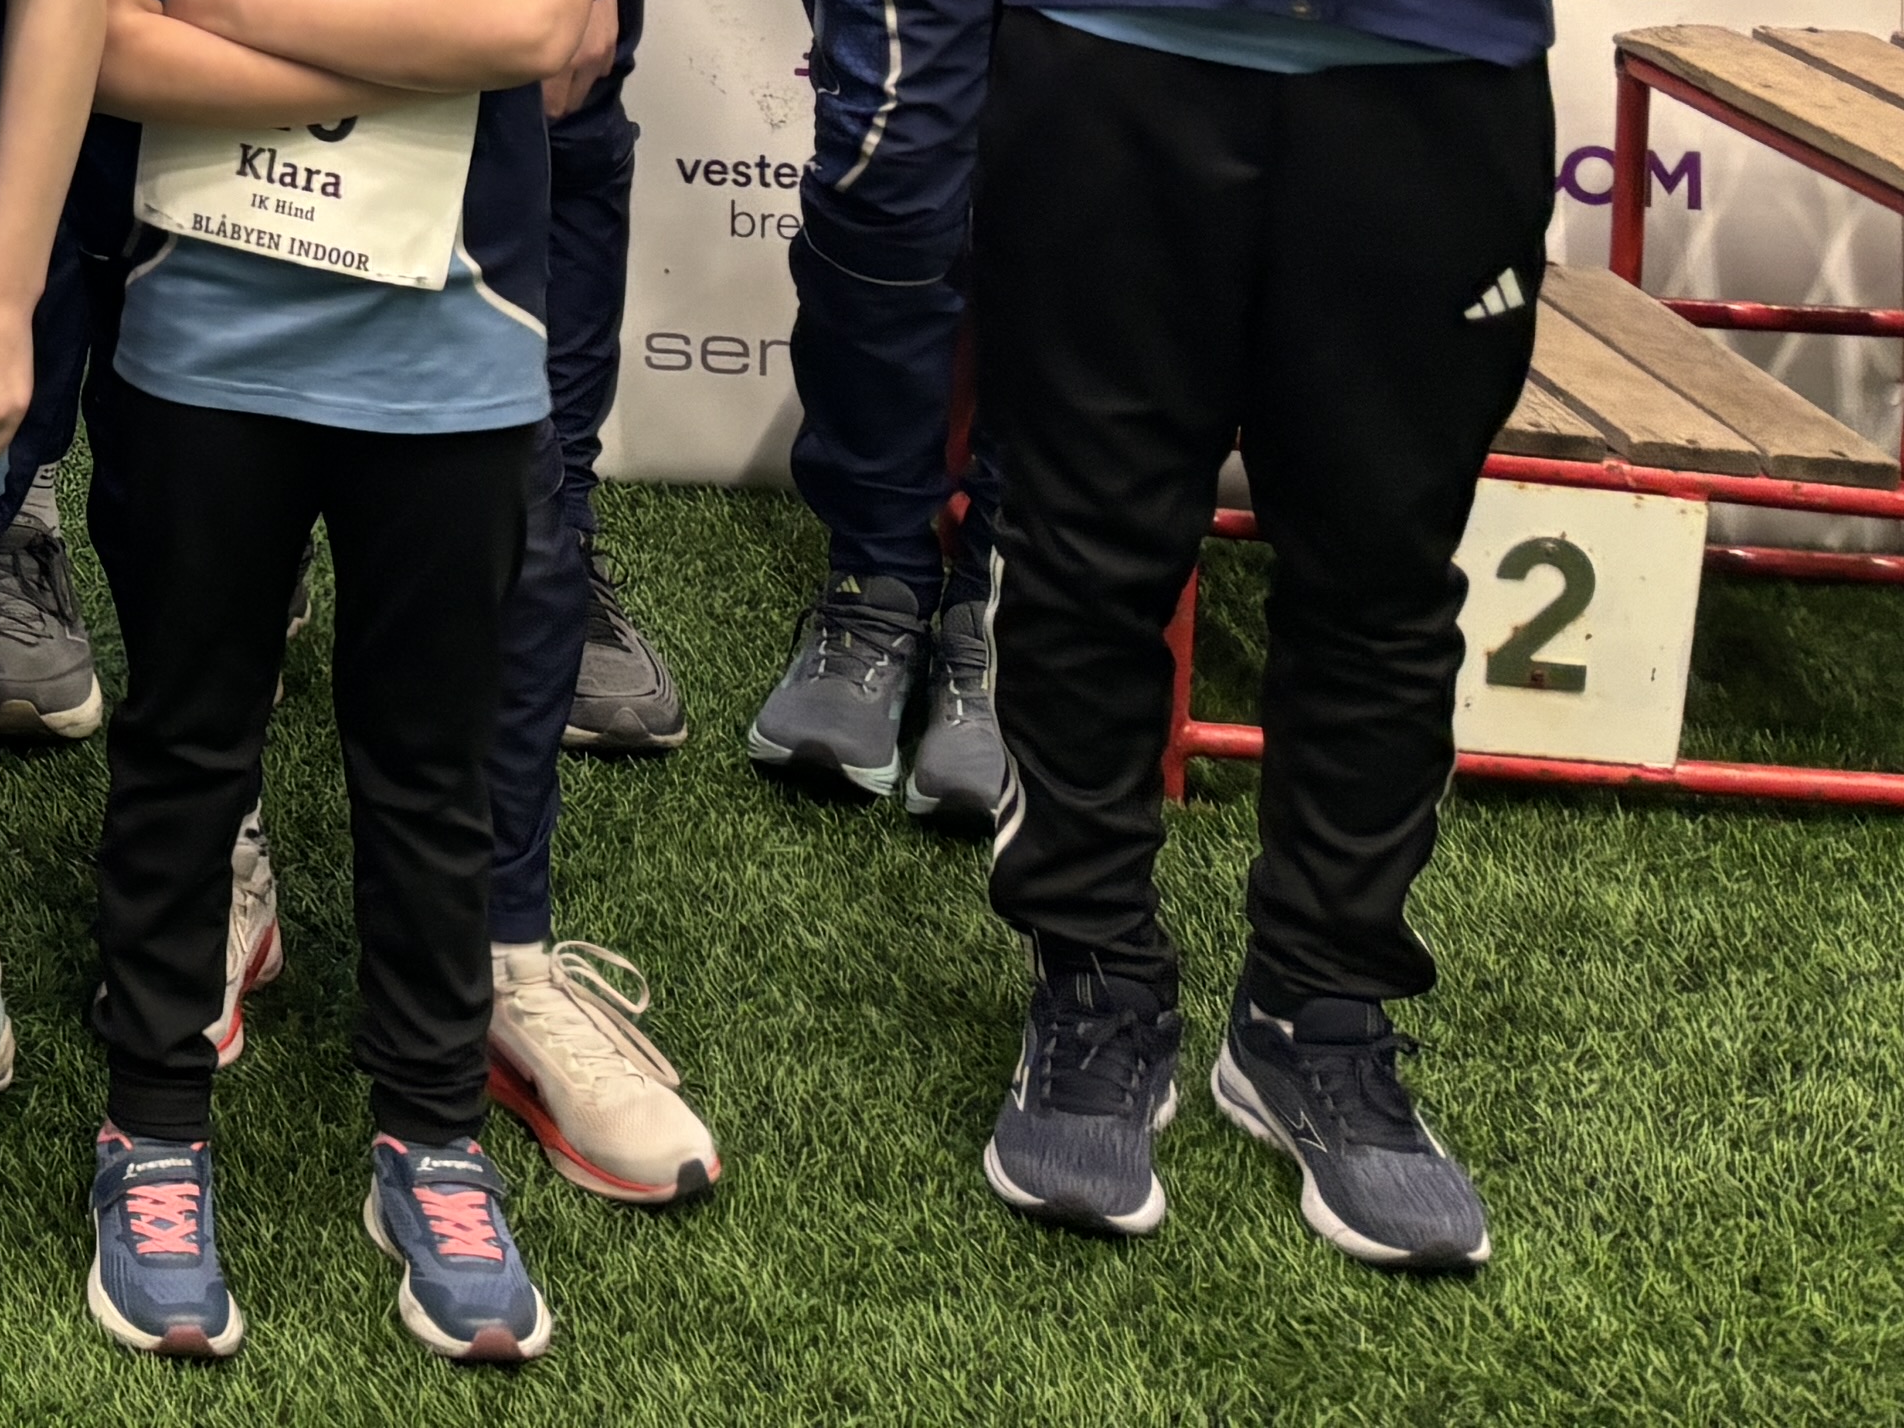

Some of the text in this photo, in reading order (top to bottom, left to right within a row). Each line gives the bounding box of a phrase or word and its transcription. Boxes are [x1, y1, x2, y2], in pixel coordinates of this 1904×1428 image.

[236, 142, 343, 199] Klara
[250, 193, 315, 221] IK Hind
[192, 214, 370, 272] BLÅBYEN INDOOR
[645, 333, 791, 376] ser
[1485, 536, 1594, 693] 2
